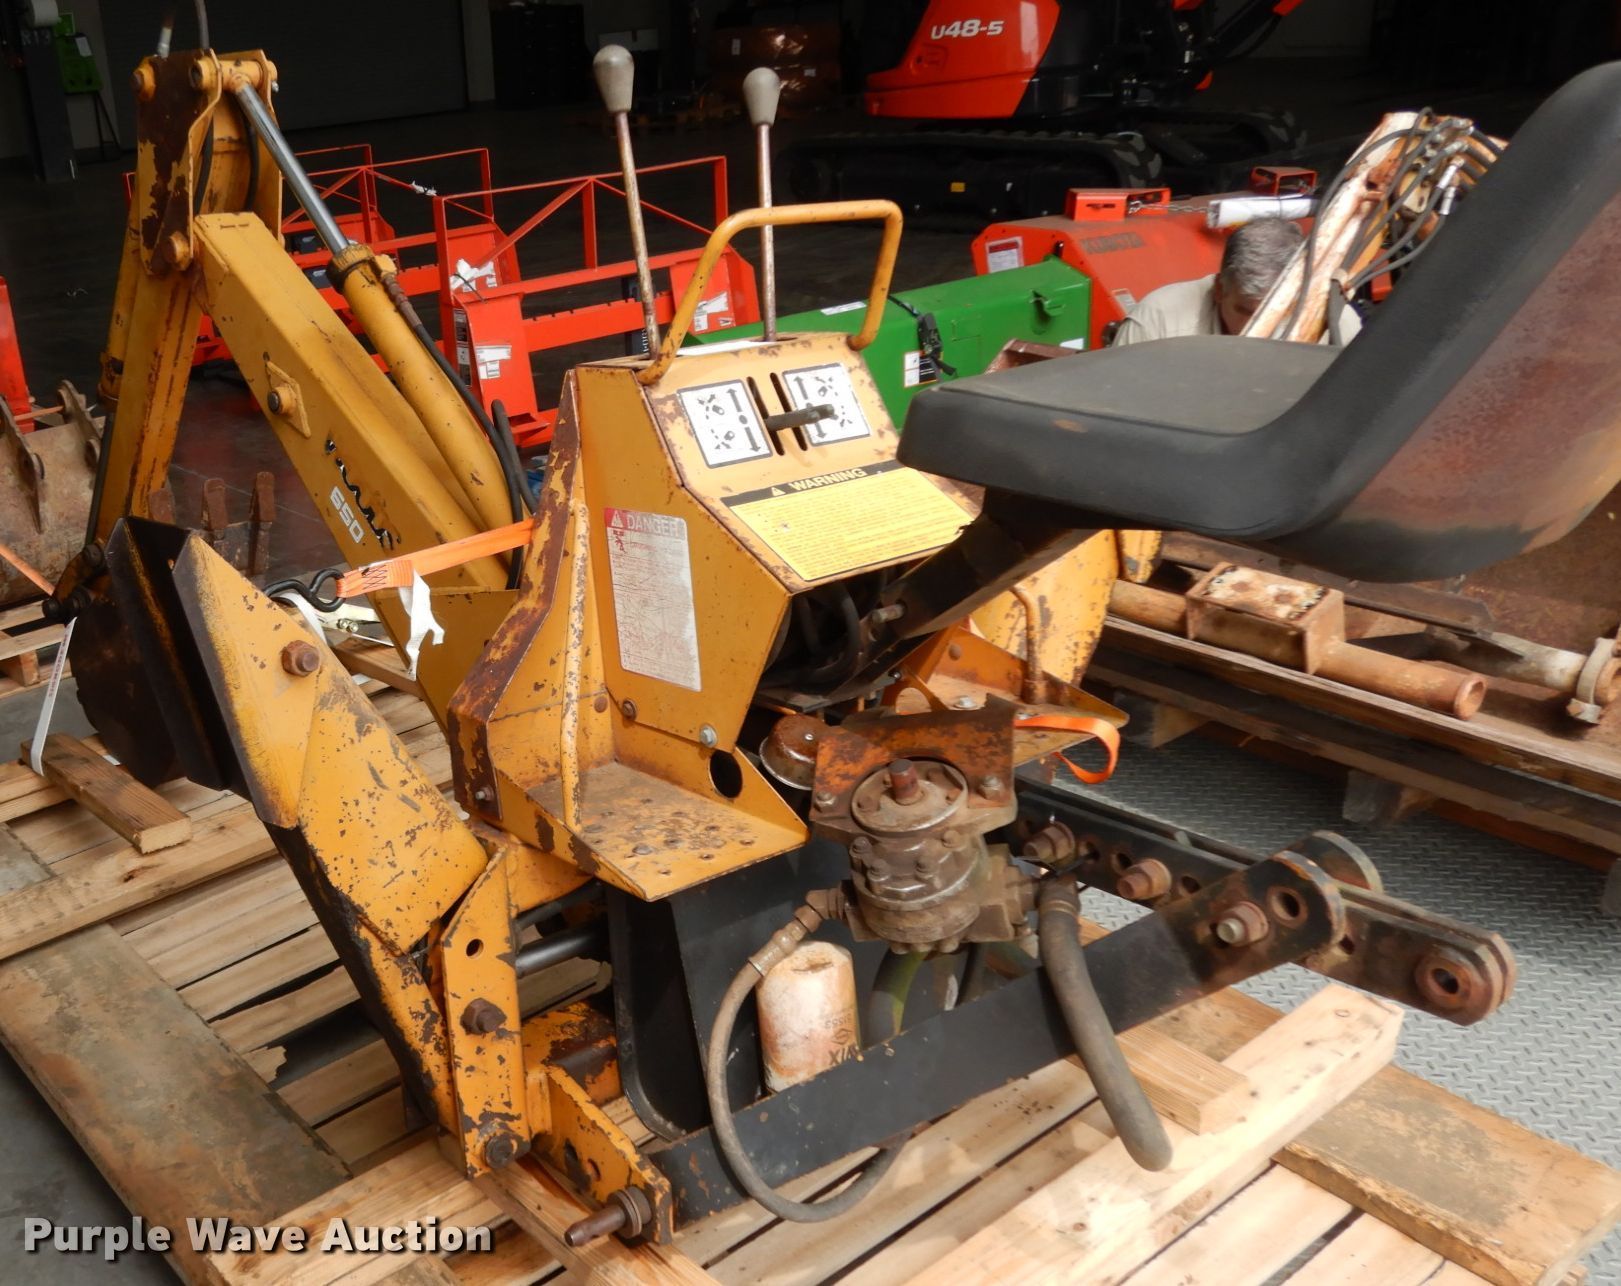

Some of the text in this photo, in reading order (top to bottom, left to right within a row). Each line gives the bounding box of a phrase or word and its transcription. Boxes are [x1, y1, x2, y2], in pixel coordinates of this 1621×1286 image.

[931, 19, 1004, 39] U48-5
[788, 468, 868, 491] WARNING
[330, 486, 365, 543] 650
[626, 514, 680, 538] DANGER
